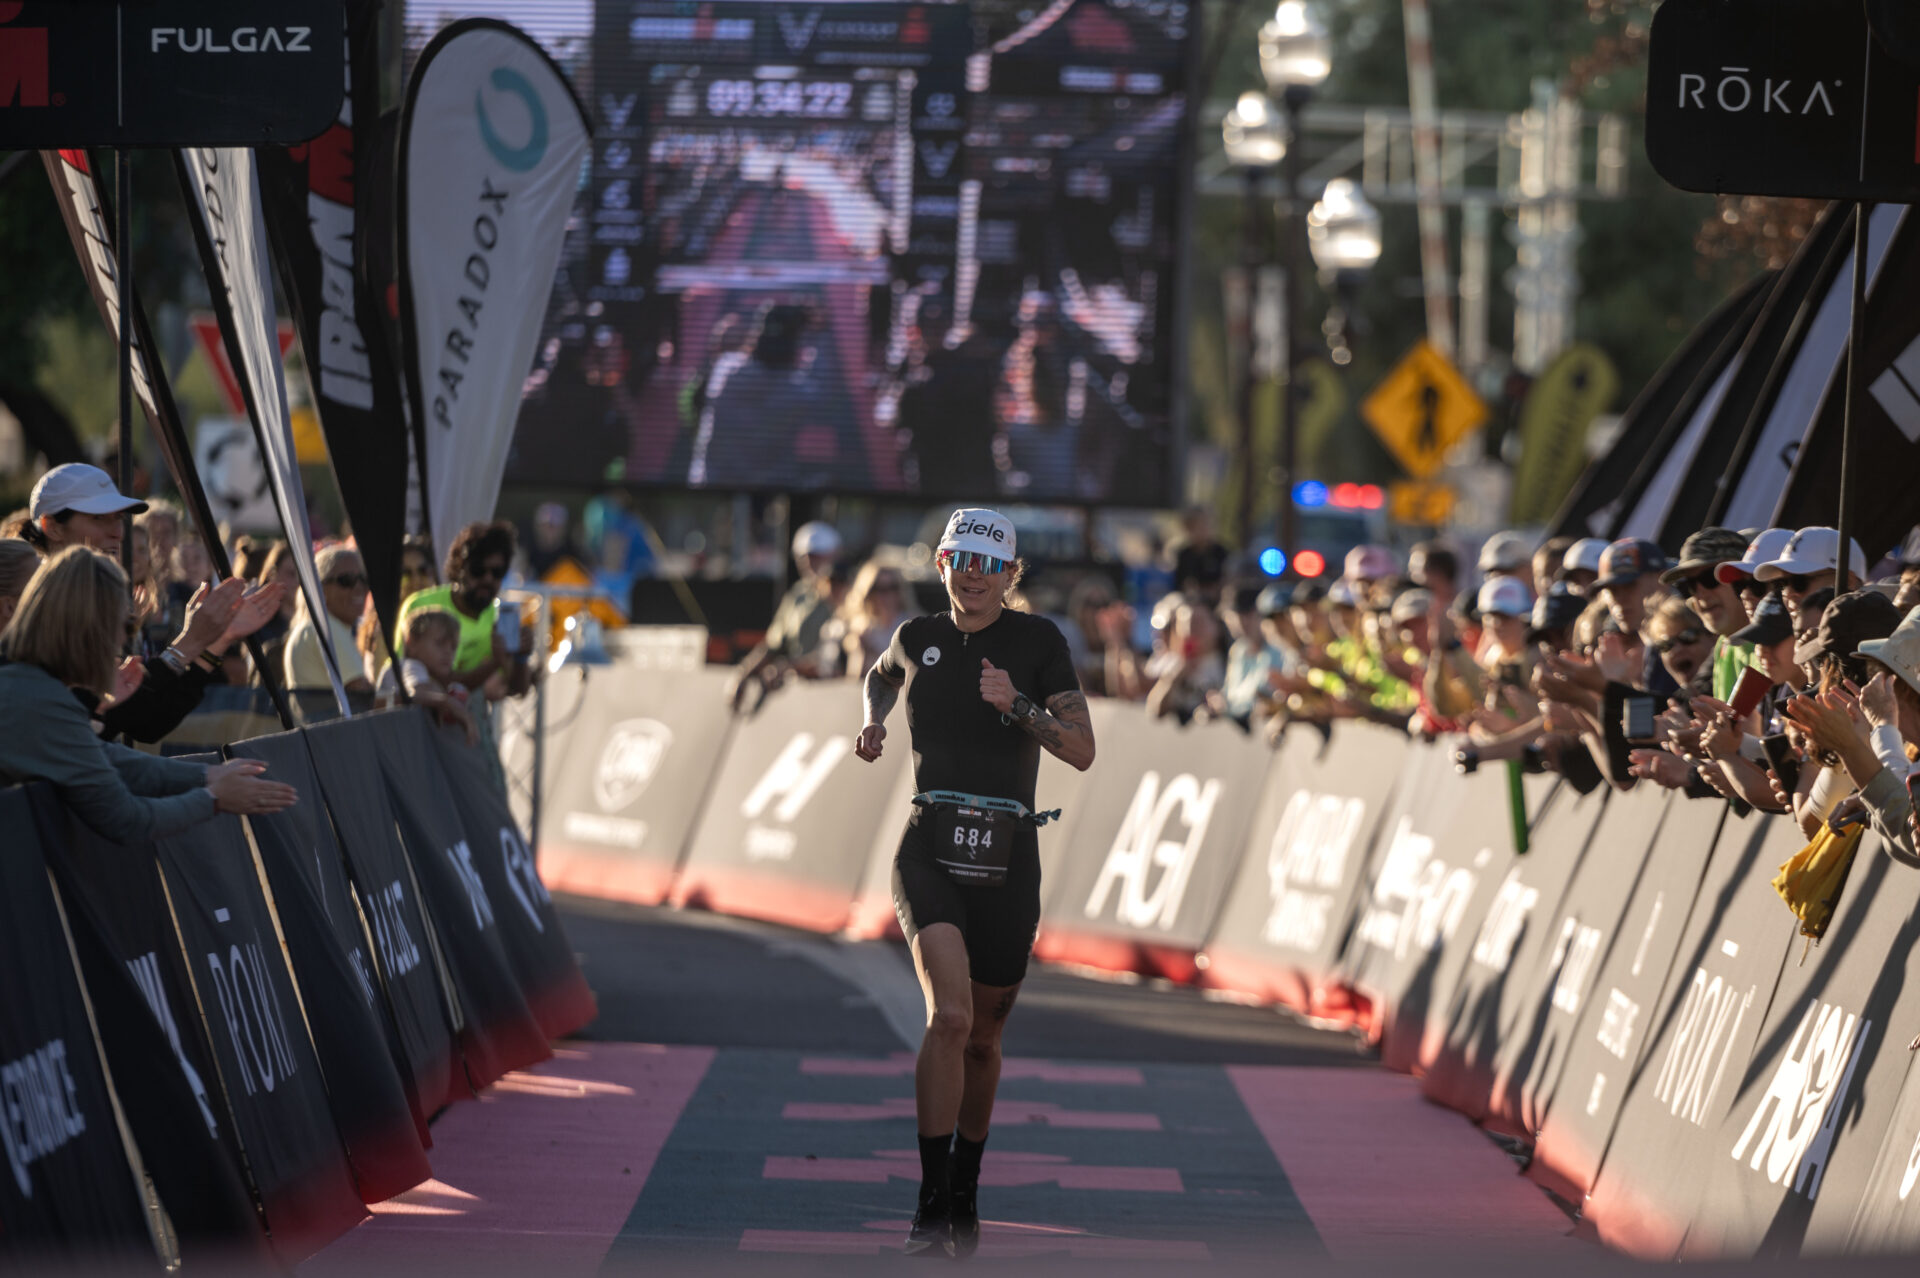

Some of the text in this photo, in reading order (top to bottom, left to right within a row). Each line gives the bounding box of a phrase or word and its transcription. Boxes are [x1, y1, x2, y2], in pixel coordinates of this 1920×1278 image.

[151, 27, 311, 52] FULGAZ
[432, 174, 509, 430] PARADOX
[955, 519, 1005, 543] ciele
[953, 826, 993, 848] 684
[1730, 998, 1872, 1200] HOKA
